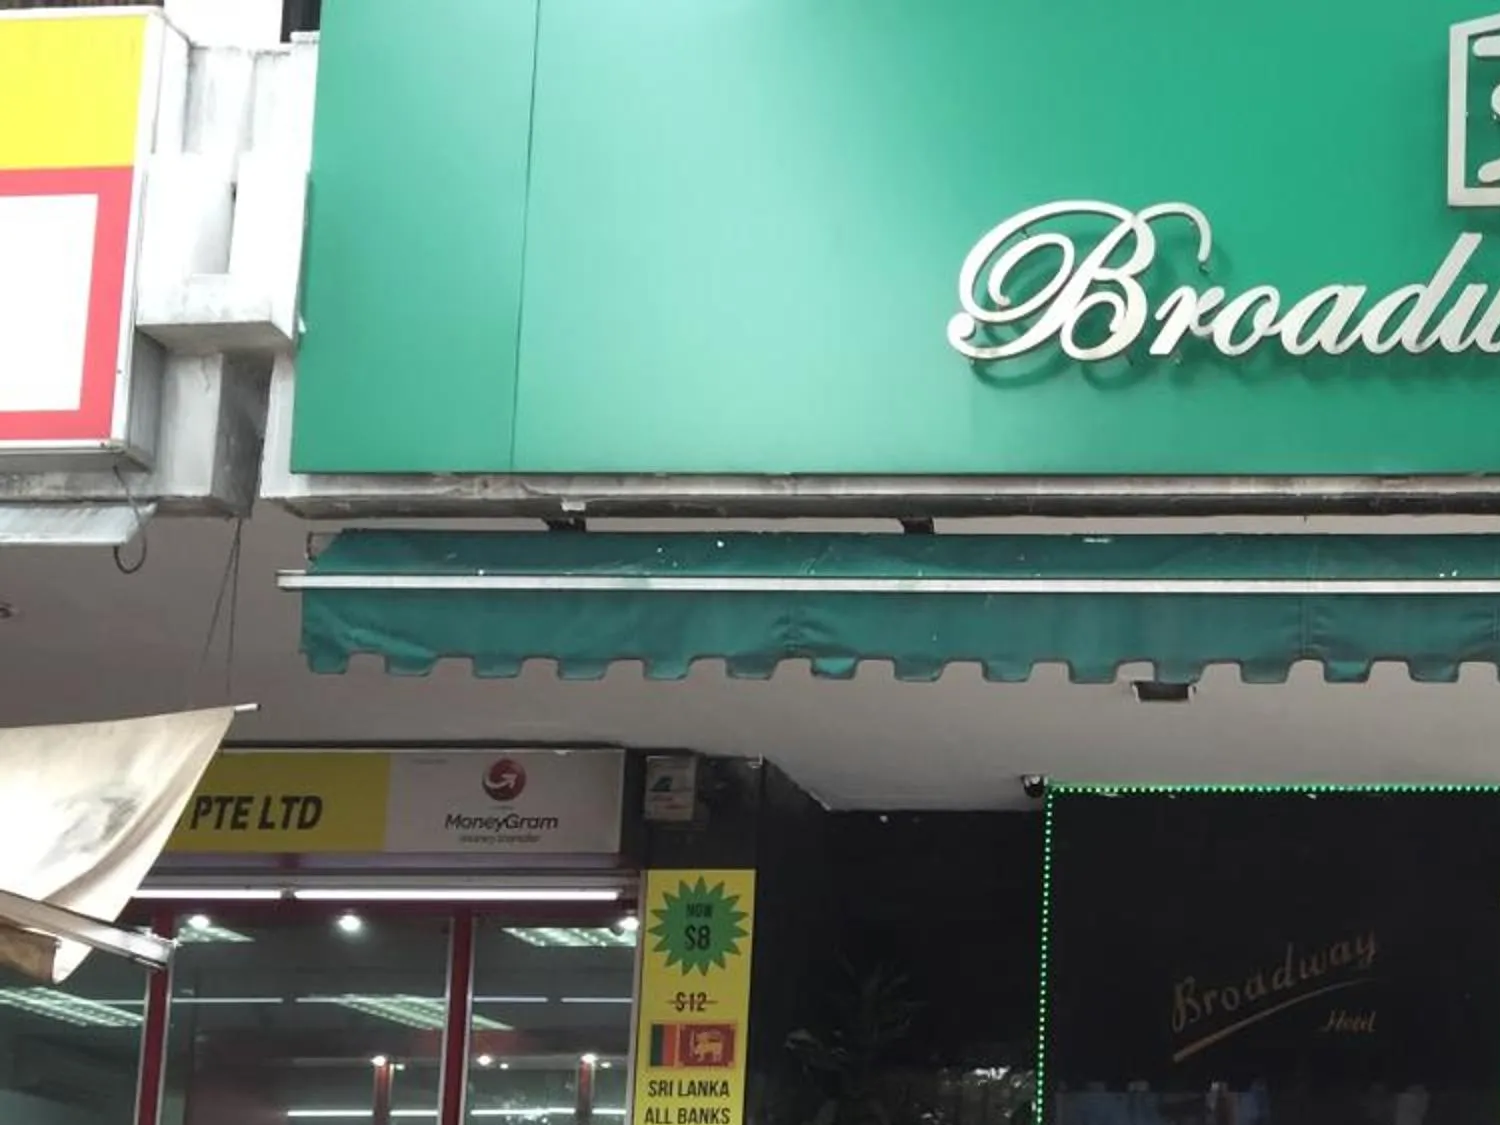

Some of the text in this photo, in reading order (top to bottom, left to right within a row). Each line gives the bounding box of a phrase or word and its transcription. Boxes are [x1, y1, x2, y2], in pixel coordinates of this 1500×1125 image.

[189, 795, 323, 831] PTE LTD
[444, 810, 559, 833] MoneyGram
[686, 903, 714, 918] NOW
[684, 924, 711, 951] $8
[1172, 929, 1377, 1033] Broadway
[674, 991, 708, 1013] $12
[647, 1079, 731, 1098] SRI LANKA
[643, 1106, 732, 1125] ALL BANKS
